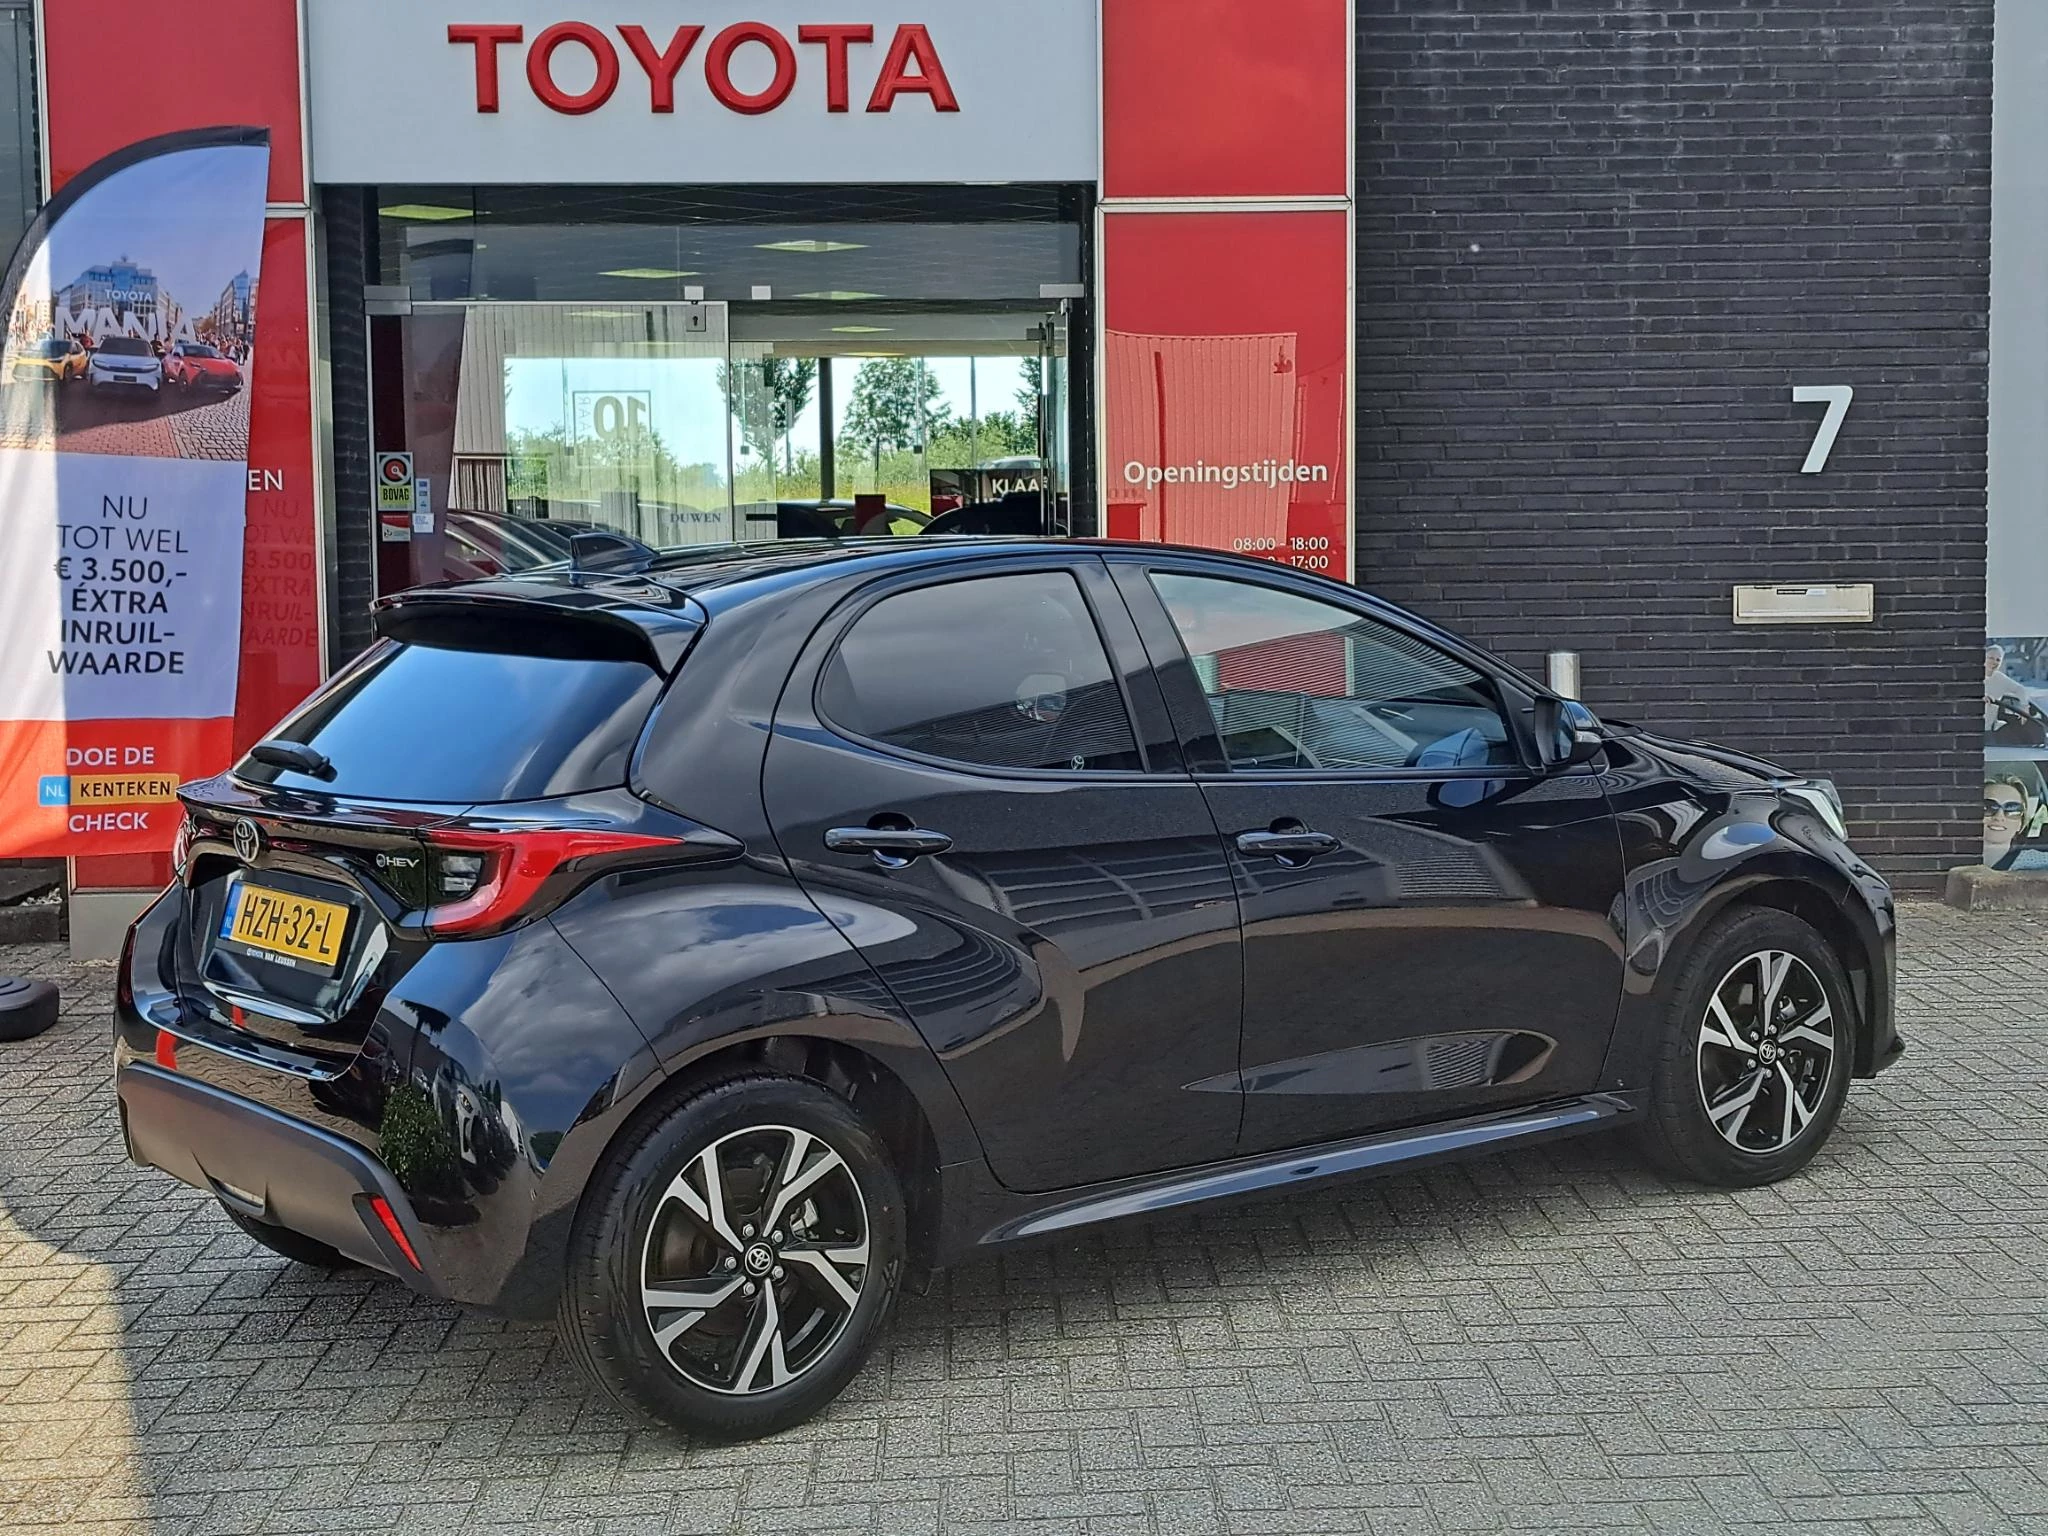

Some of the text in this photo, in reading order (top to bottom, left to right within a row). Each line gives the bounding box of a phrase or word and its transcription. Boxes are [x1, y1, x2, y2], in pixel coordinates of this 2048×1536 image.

[448, 21, 960, 115] TOYOTA
[104, 289, 153, 302] TOYOTA
[55, 306, 197, 348] MANIA
[1792, 385, 1854, 474] 7
[248, 469, 284, 491] EN
[1124, 459, 1328, 490] Openingstijden
[383, 488, 410, 501] BOVAG
[102, 494, 148, 521] NU
[670, 512, 721, 524] DUWEN
[57, 524, 189, 554] TOT WEL
[246, 523, 271, 544] OT
[1233, 537, 1276, 551] 08:00
[1290, 536, 1329, 550] 18:00
[54, 557, 188, 588] € 3.500,-
[1290, 555, 1329, 569] 17:00
[72, 583, 168, 614] ÉXTRA
[60, 619, 175, 646] INRUIL-
[246, 625, 317, 648] AARDE
[47, 650, 185, 675] WAARDE
[67, 746, 155, 767] DOE DE
[45, 779, 172, 798] NL KENTEKEN
[68, 811, 148, 833] CHECK
[386, 856, 420, 868] HEV
[239, 893, 331, 955] HZH-32-L
